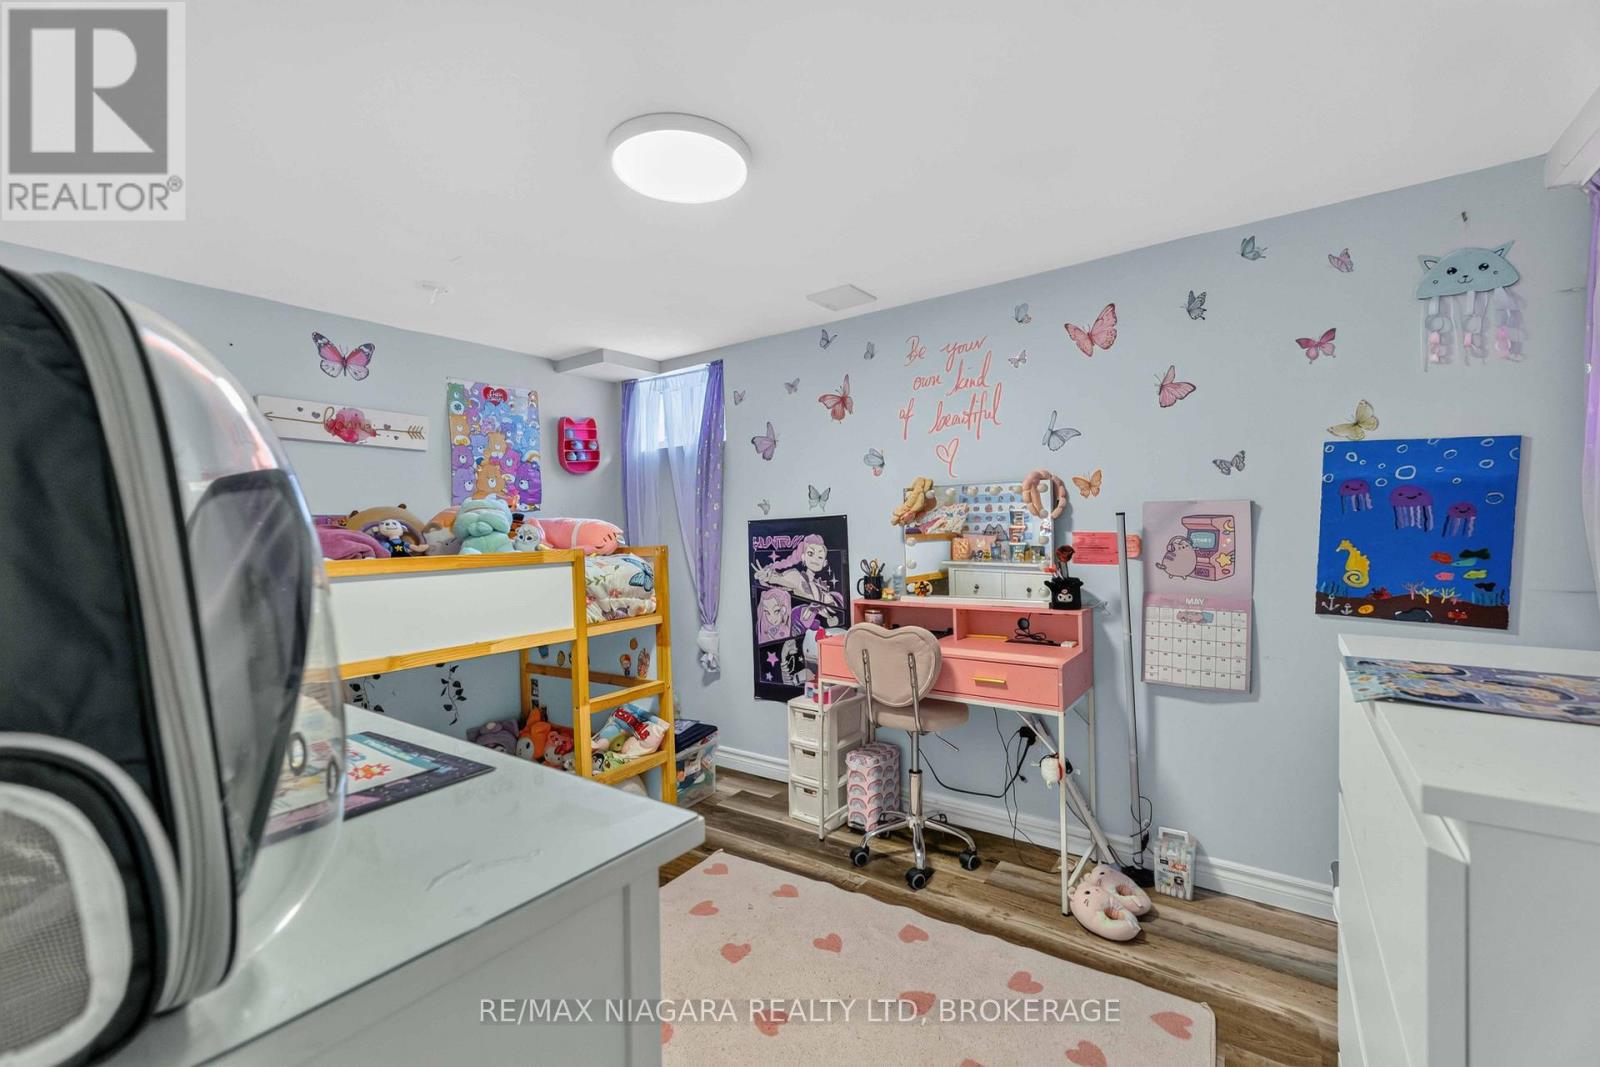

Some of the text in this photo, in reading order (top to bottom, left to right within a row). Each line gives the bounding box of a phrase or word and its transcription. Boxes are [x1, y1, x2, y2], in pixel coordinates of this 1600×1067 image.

[904, 336, 988, 372] Be your
[912, 350, 992, 396] own kind
[899, 382, 1002, 440] of beautiful
[1185, 597, 1206, 606] MAY
